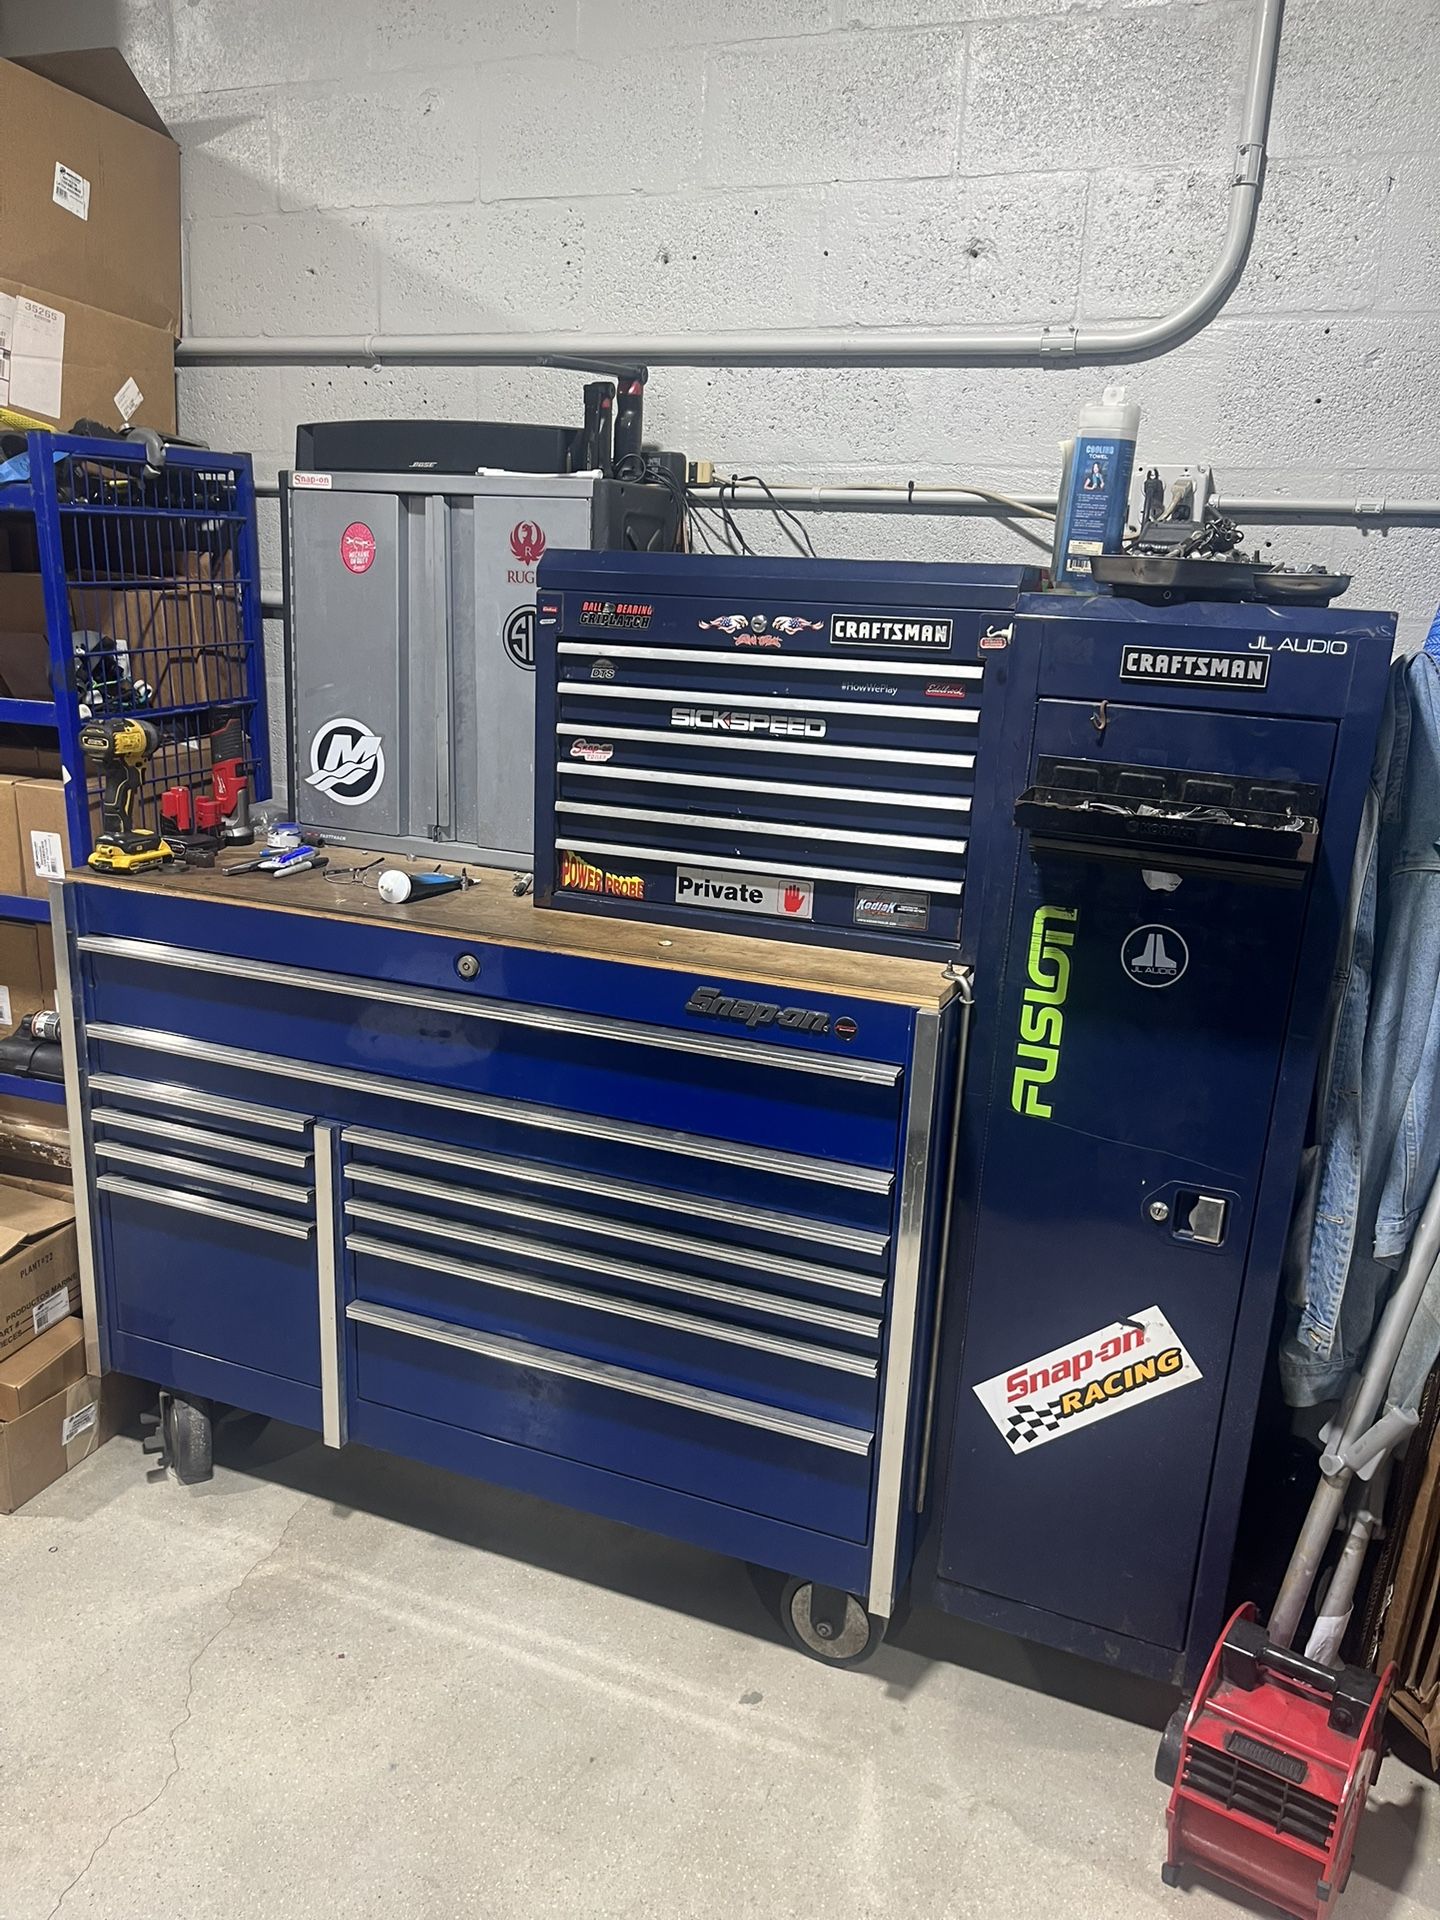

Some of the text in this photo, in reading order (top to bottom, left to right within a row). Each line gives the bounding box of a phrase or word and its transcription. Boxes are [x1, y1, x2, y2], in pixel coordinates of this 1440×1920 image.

[25, 302, 57, 321] 35265
[294, 474, 330, 485] Snap-on
[580, 612, 651, 629] GRIPLATCH
[583, 601, 653, 616] BALL BEARING
[834, 620, 948, 644] CRAFTSMAN
[1248, 635, 1348, 656] JL AUDIO
[590, 668, 616, 679] DTS
[1126, 652, 1264, 680] CRAFTSMAN
[841, 680, 898, 696] #HowWePlay
[670, 707, 827, 738] SICKSPEED
[561, 850, 645, 899] POWER PROBE
[678, 876, 763, 904] Private
[1145, 967, 1177, 976] AUDIO
[685, 986, 830, 1031] Snap-on
[6, 1290, 50, 1324] PRODUCTOS
[1006, 1329, 1145, 1403] Snap-on
[1060, 1348, 1182, 1415] RACING
